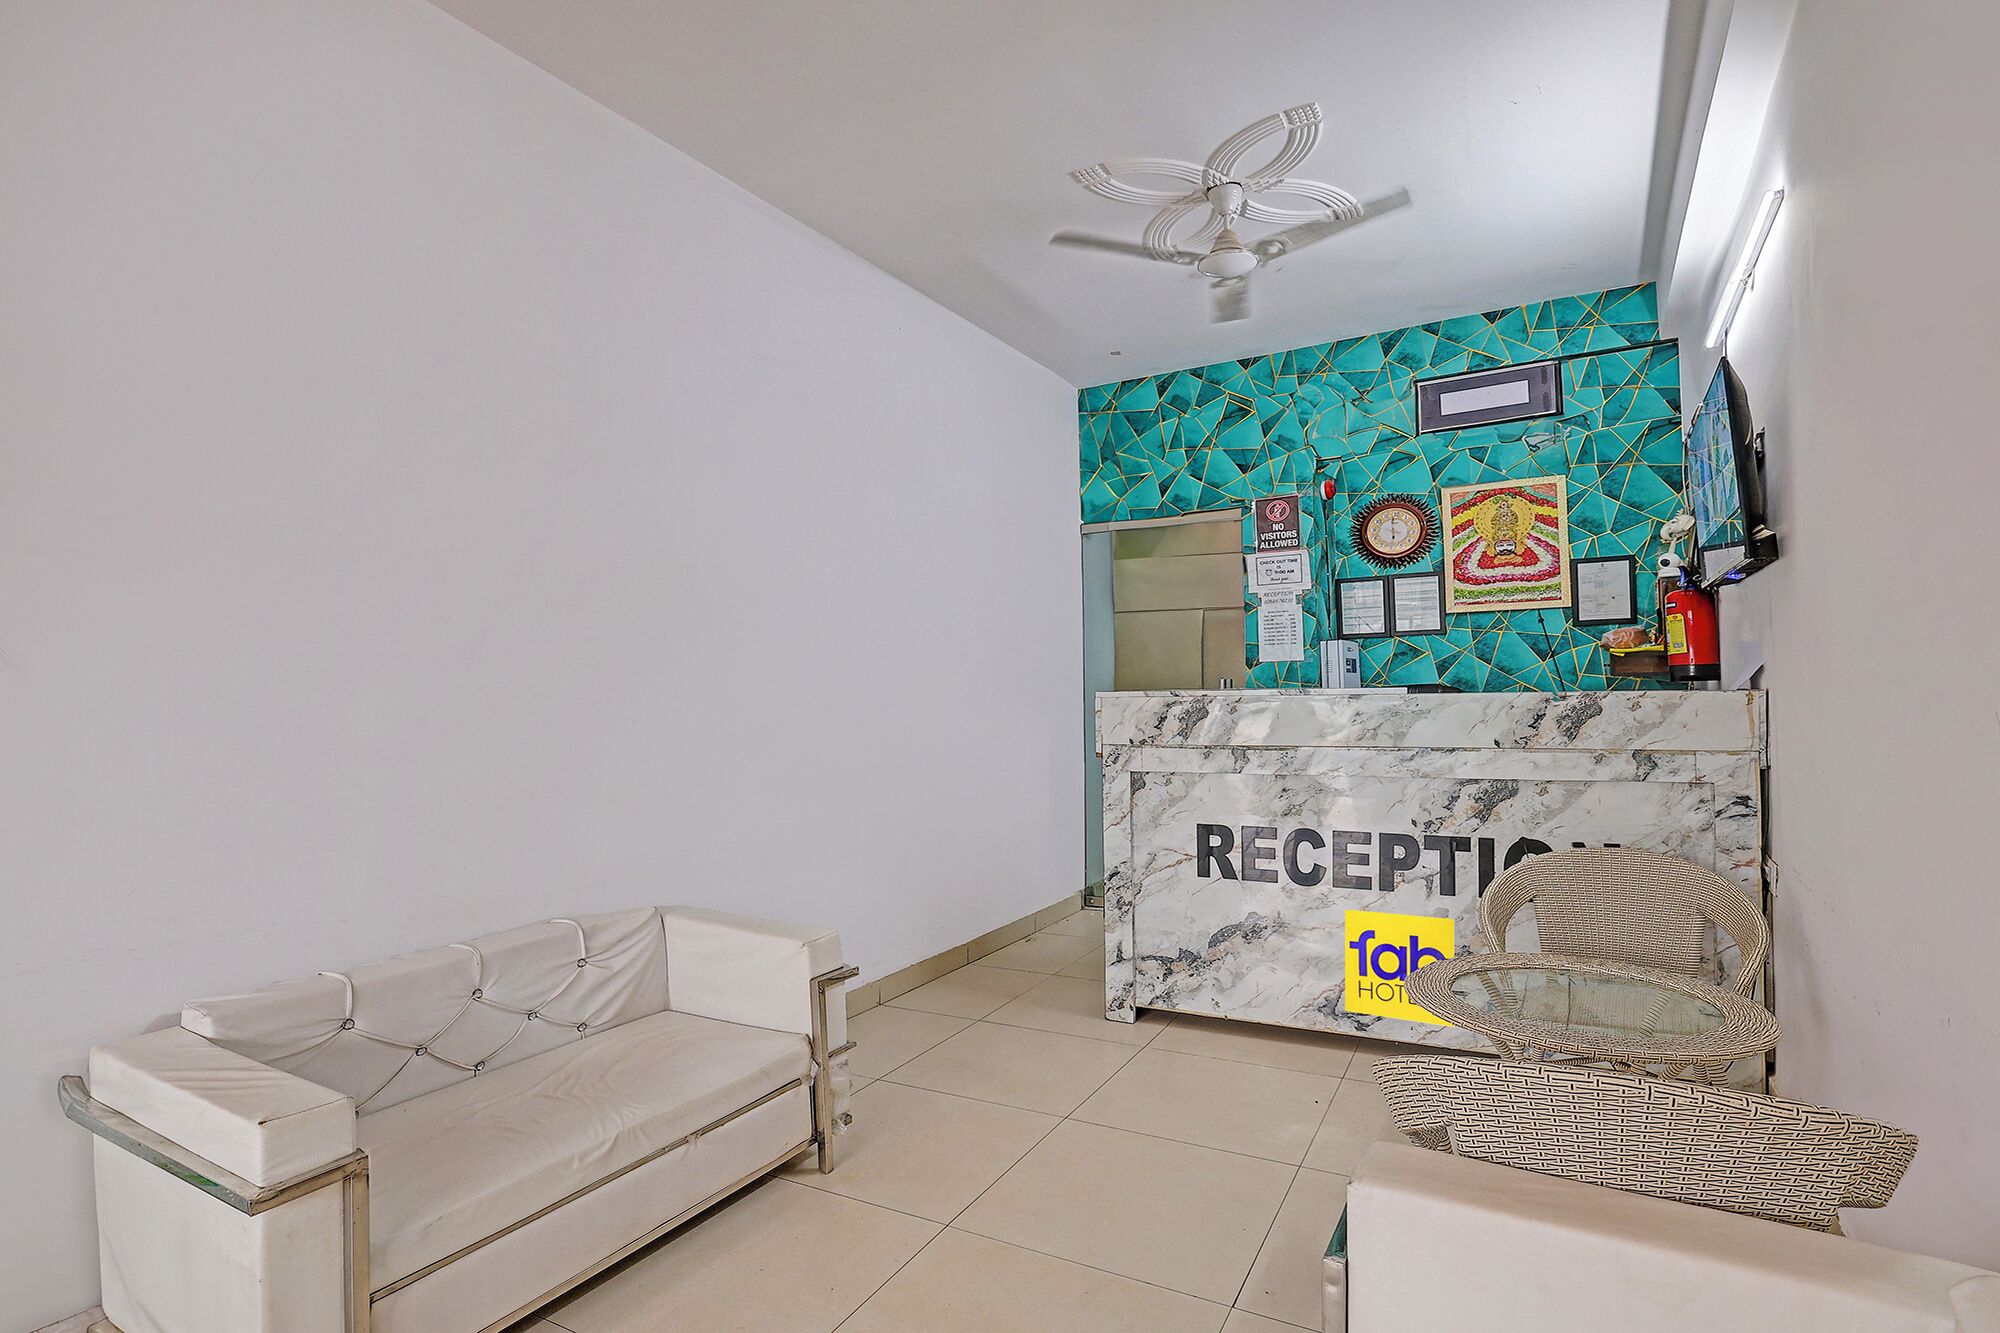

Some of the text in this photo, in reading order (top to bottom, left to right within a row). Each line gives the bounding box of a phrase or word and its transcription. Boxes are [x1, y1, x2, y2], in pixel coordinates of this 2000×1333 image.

[1272, 522, 1284, 530] NO
[1260, 530, 1298, 540] VISITORS
[1260, 538, 1298, 549] ALLOWED
[1196, 823, 1621, 901] RECEPTI
[1349, 930, 1447, 981] fab
[1358, 980, 1419, 1004] HOT
